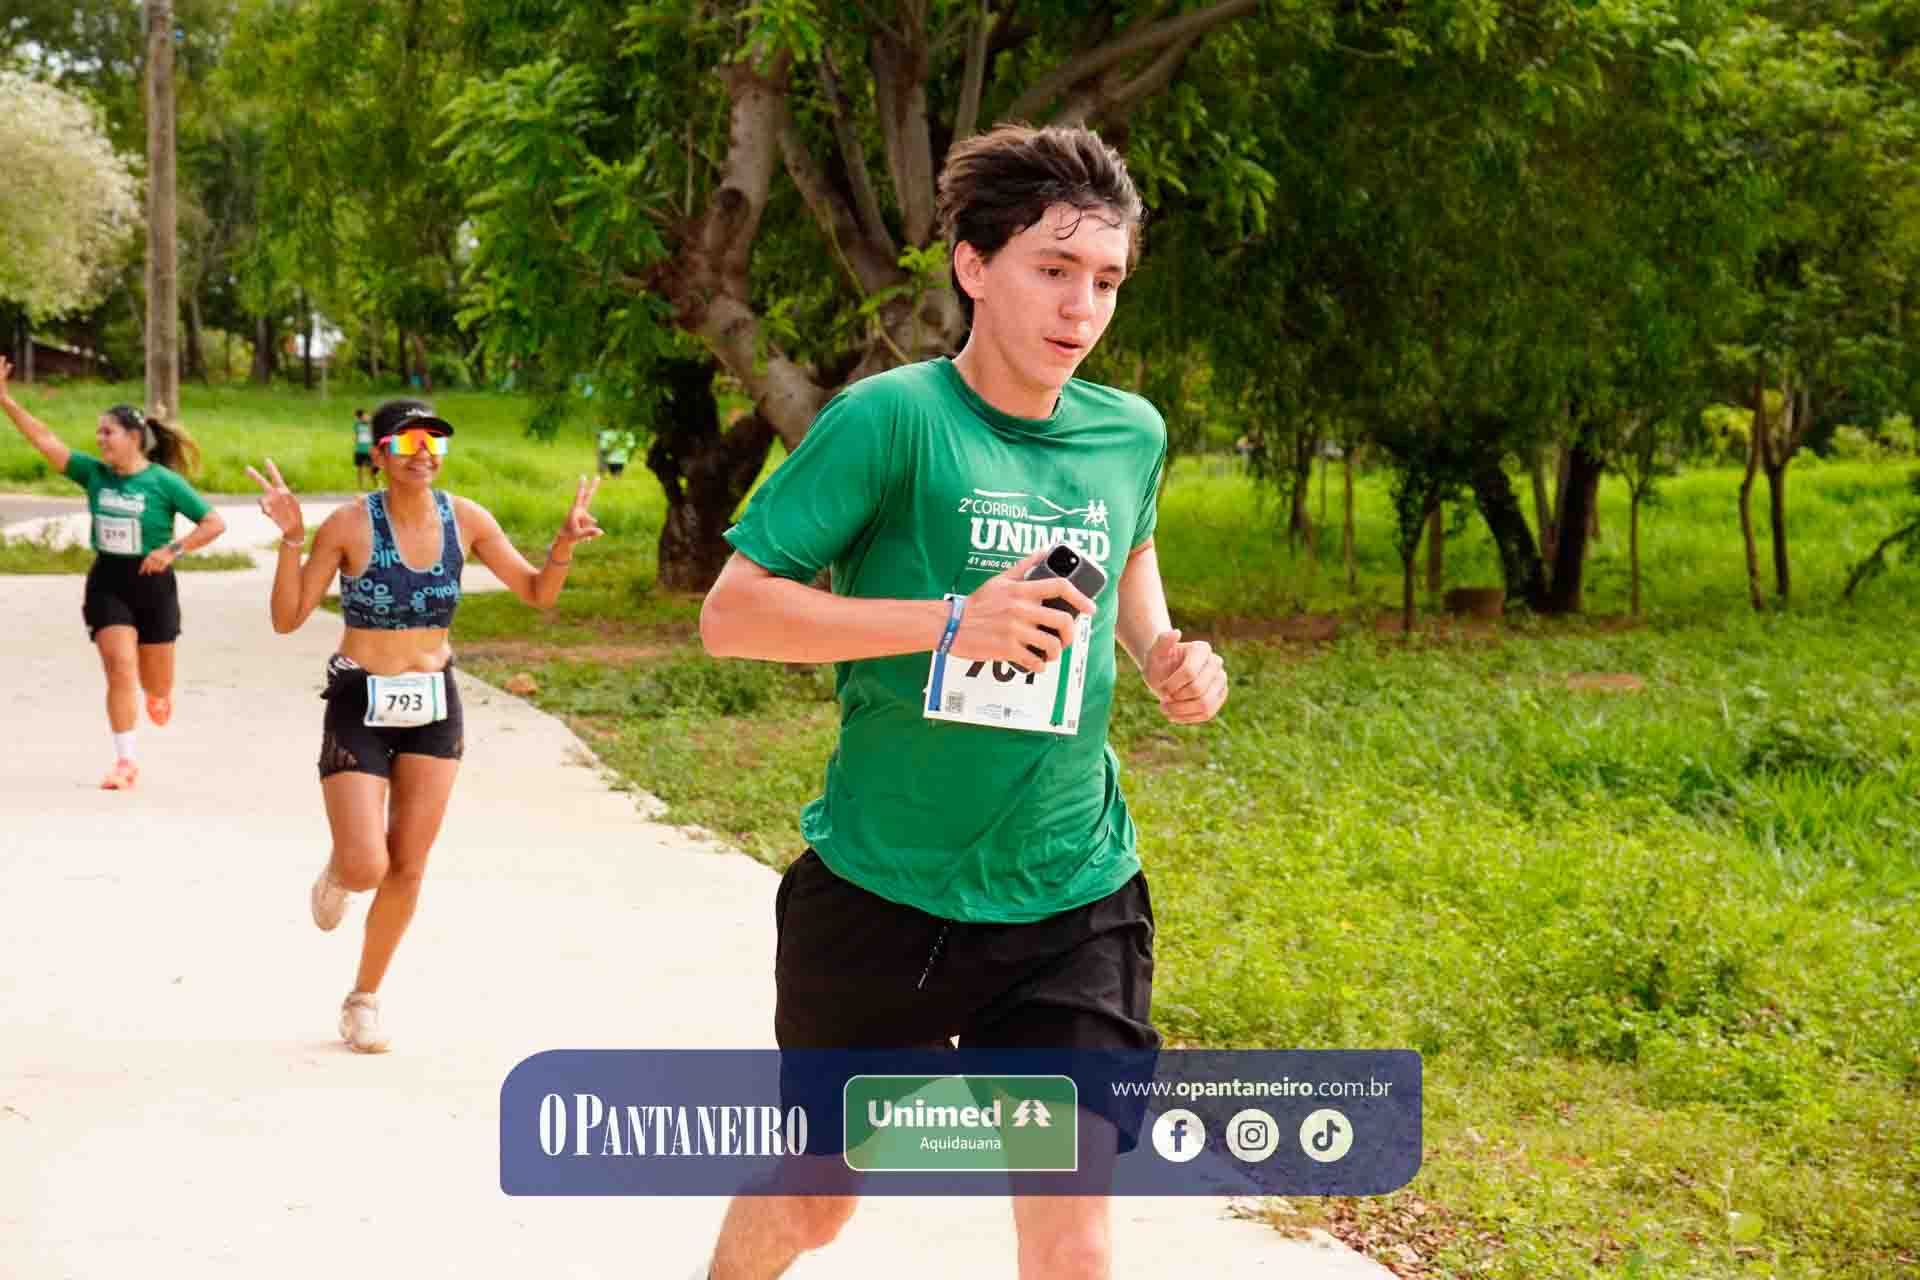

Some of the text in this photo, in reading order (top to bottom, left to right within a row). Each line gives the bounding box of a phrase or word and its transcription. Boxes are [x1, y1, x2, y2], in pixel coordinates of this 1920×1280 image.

[972, 499, 1029, 520] CORRIDA
[970, 517, 1110, 563] UNIMED
[980, 559, 1000, 569] anos
[385, 694, 423, 711] 793
